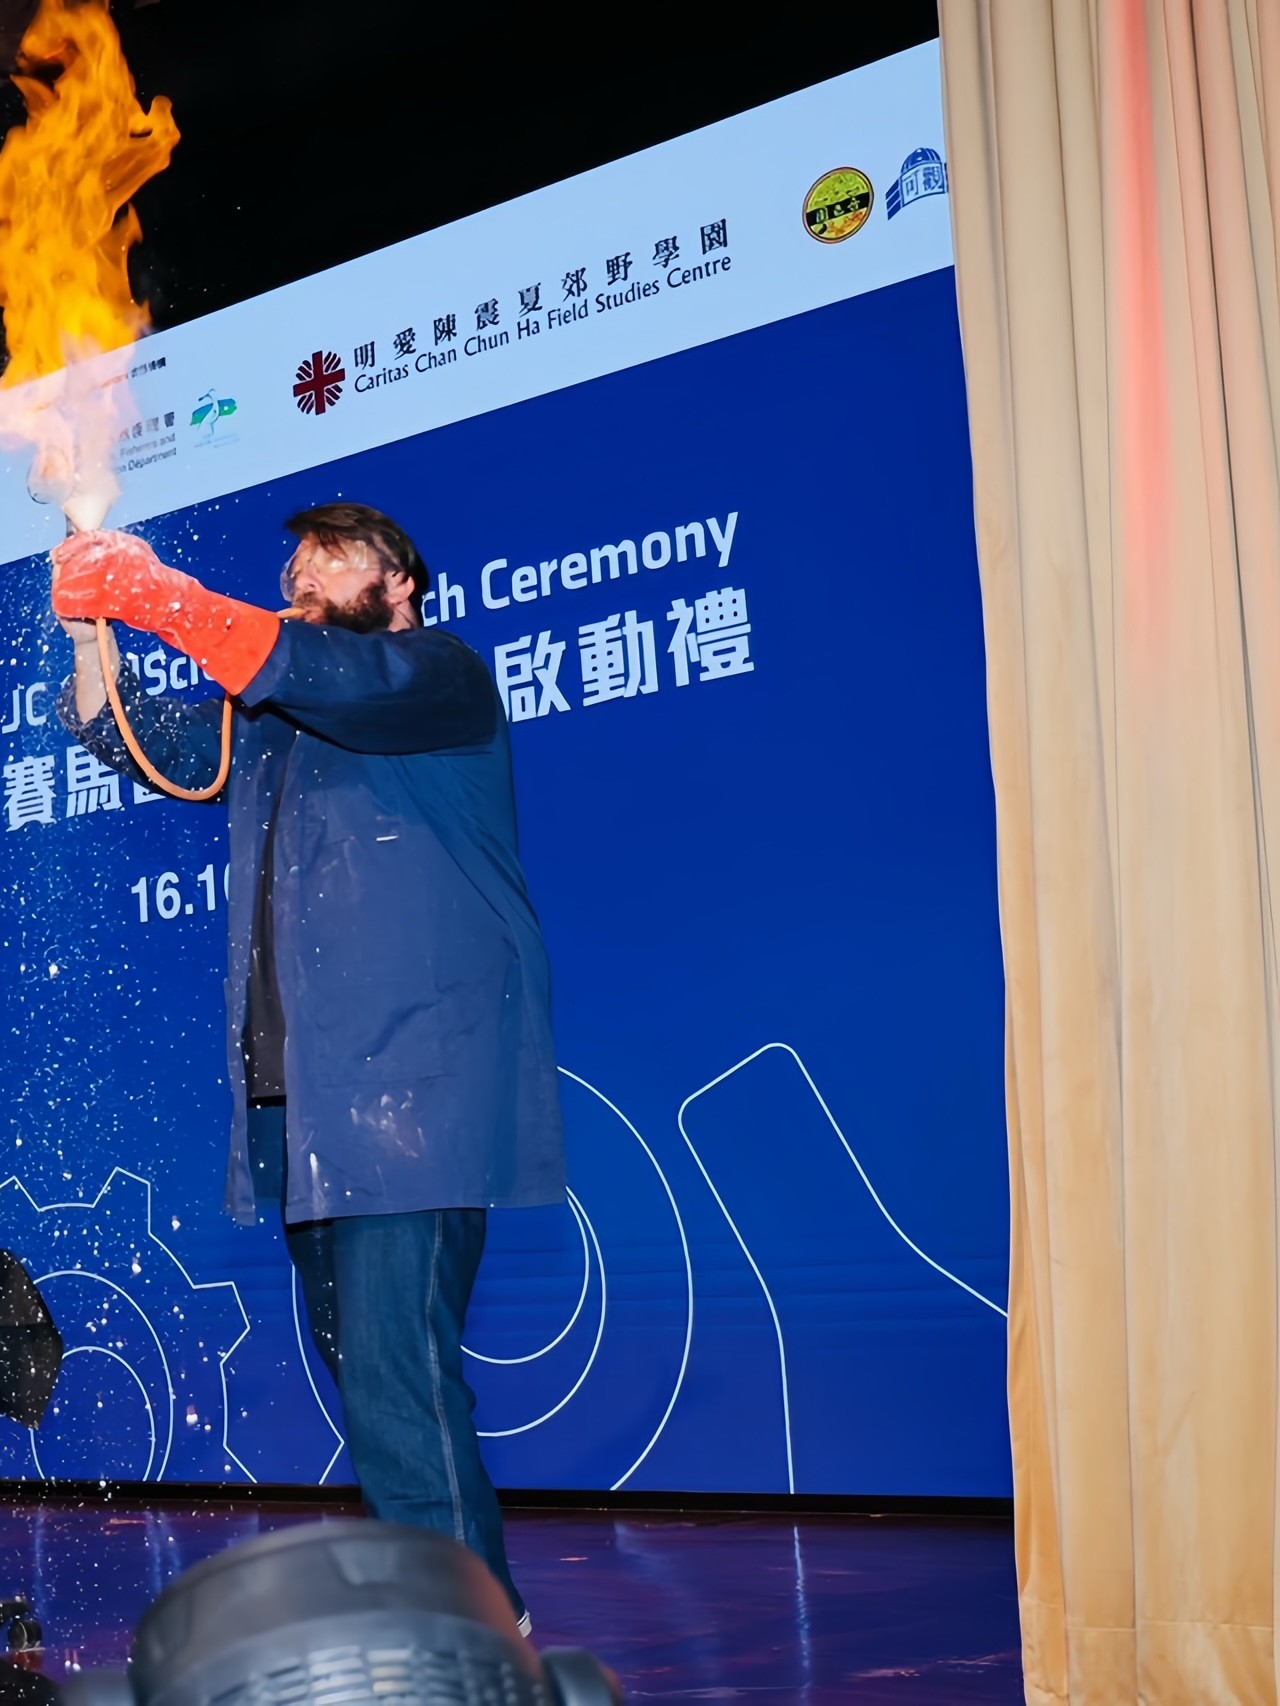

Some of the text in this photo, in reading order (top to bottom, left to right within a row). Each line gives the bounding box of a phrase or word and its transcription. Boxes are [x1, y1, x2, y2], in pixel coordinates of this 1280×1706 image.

[354, 256, 731, 393] Caritas Chan Chun Ha Field Studies Centre
[1, 682, 47, 734] JC
[480, 511, 739, 611] Ceremony
[493, 586, 755, 723] 啟動禮
[131, 862, 230, 923] 16.1
